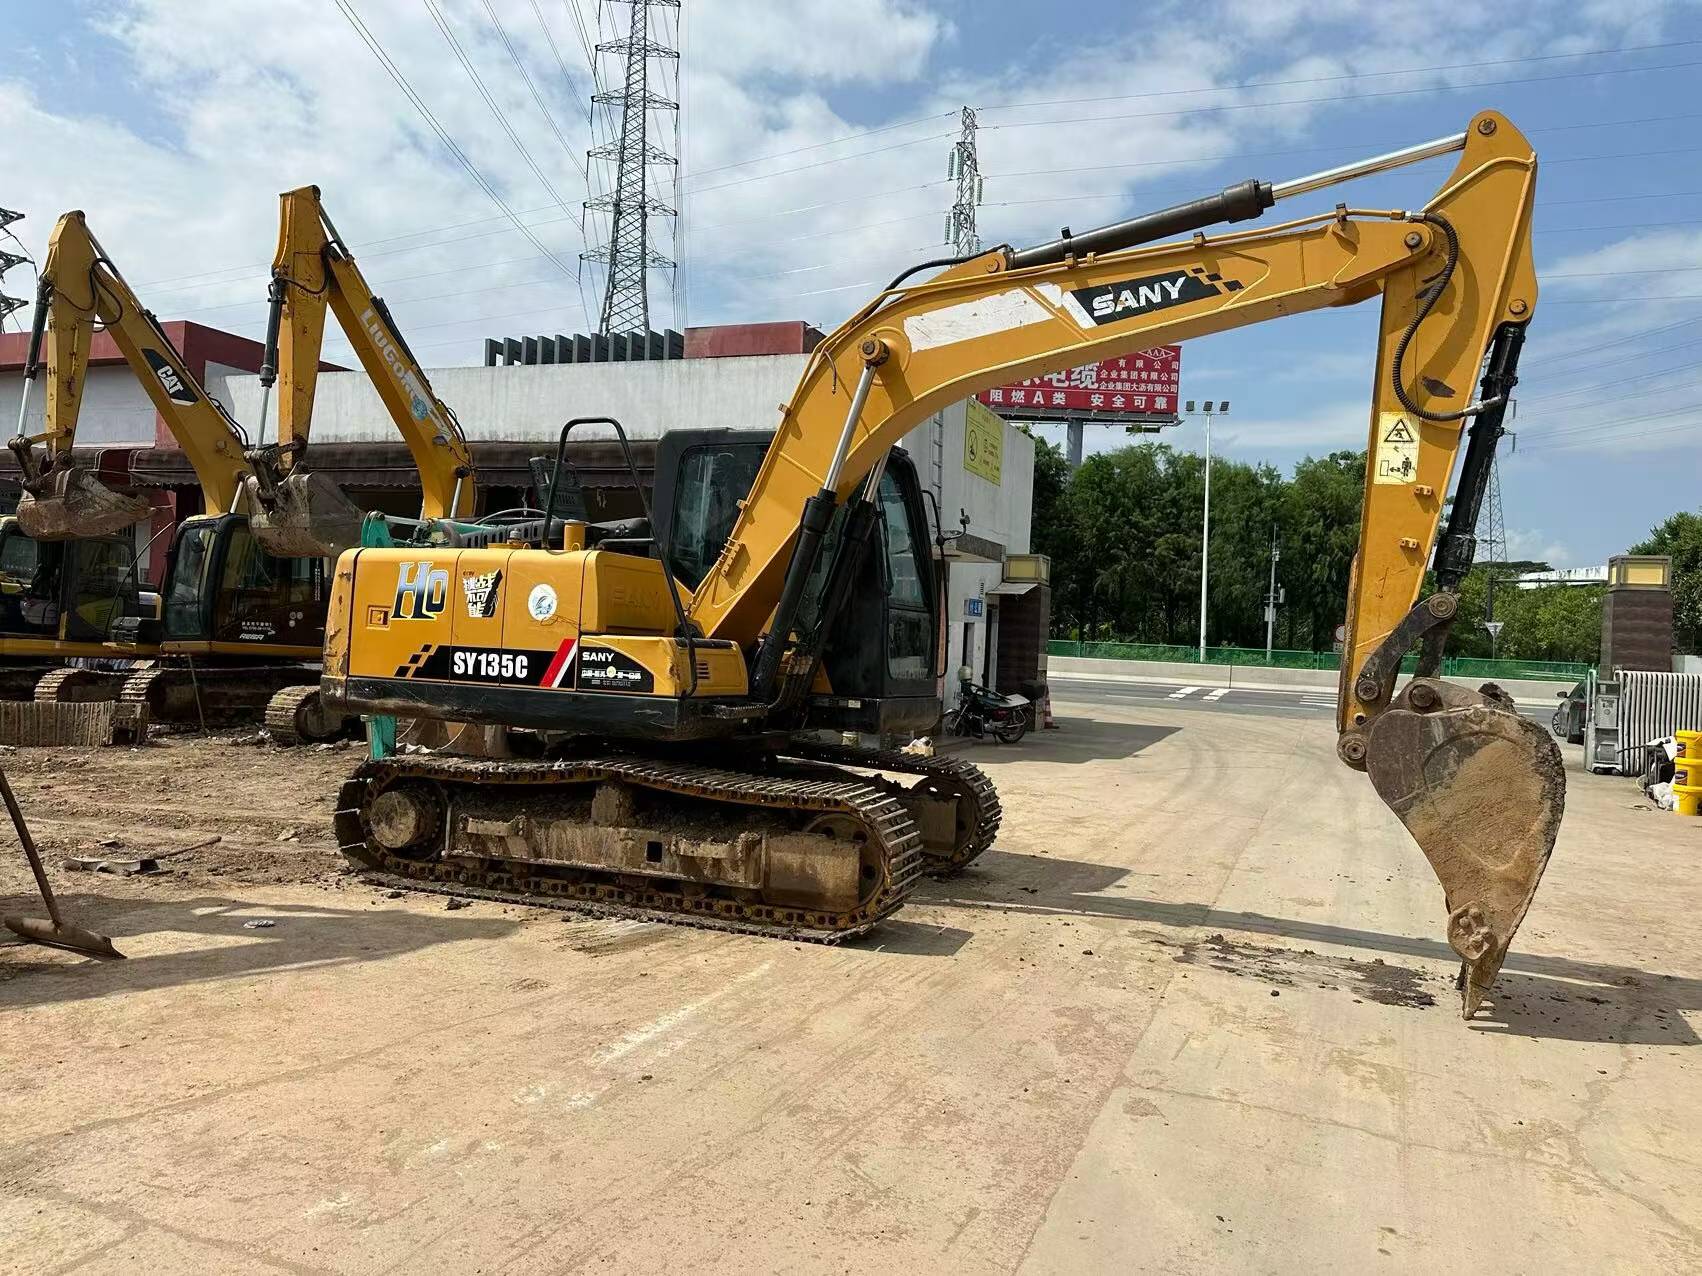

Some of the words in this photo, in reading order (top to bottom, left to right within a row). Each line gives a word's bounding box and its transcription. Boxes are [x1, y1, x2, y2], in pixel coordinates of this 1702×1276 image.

[1092, 276, 1187, 317] SANY
[1101, 358, 1179, 370] 有限公司
[1146, 349, 1166, 358] AAA
[157, 365, 184, 394] CAT
[1022, 362, 1100, 389] 电缆
[1100, 369, 1178, 382] 企业集团有限公司
[989, 389, 1066, 406] 阻燃A类
[1090, 393, 1168, 410] 安全可靠
[453, 651, 529, 679] SY135C
[582, 651, 615, 662] SANY
